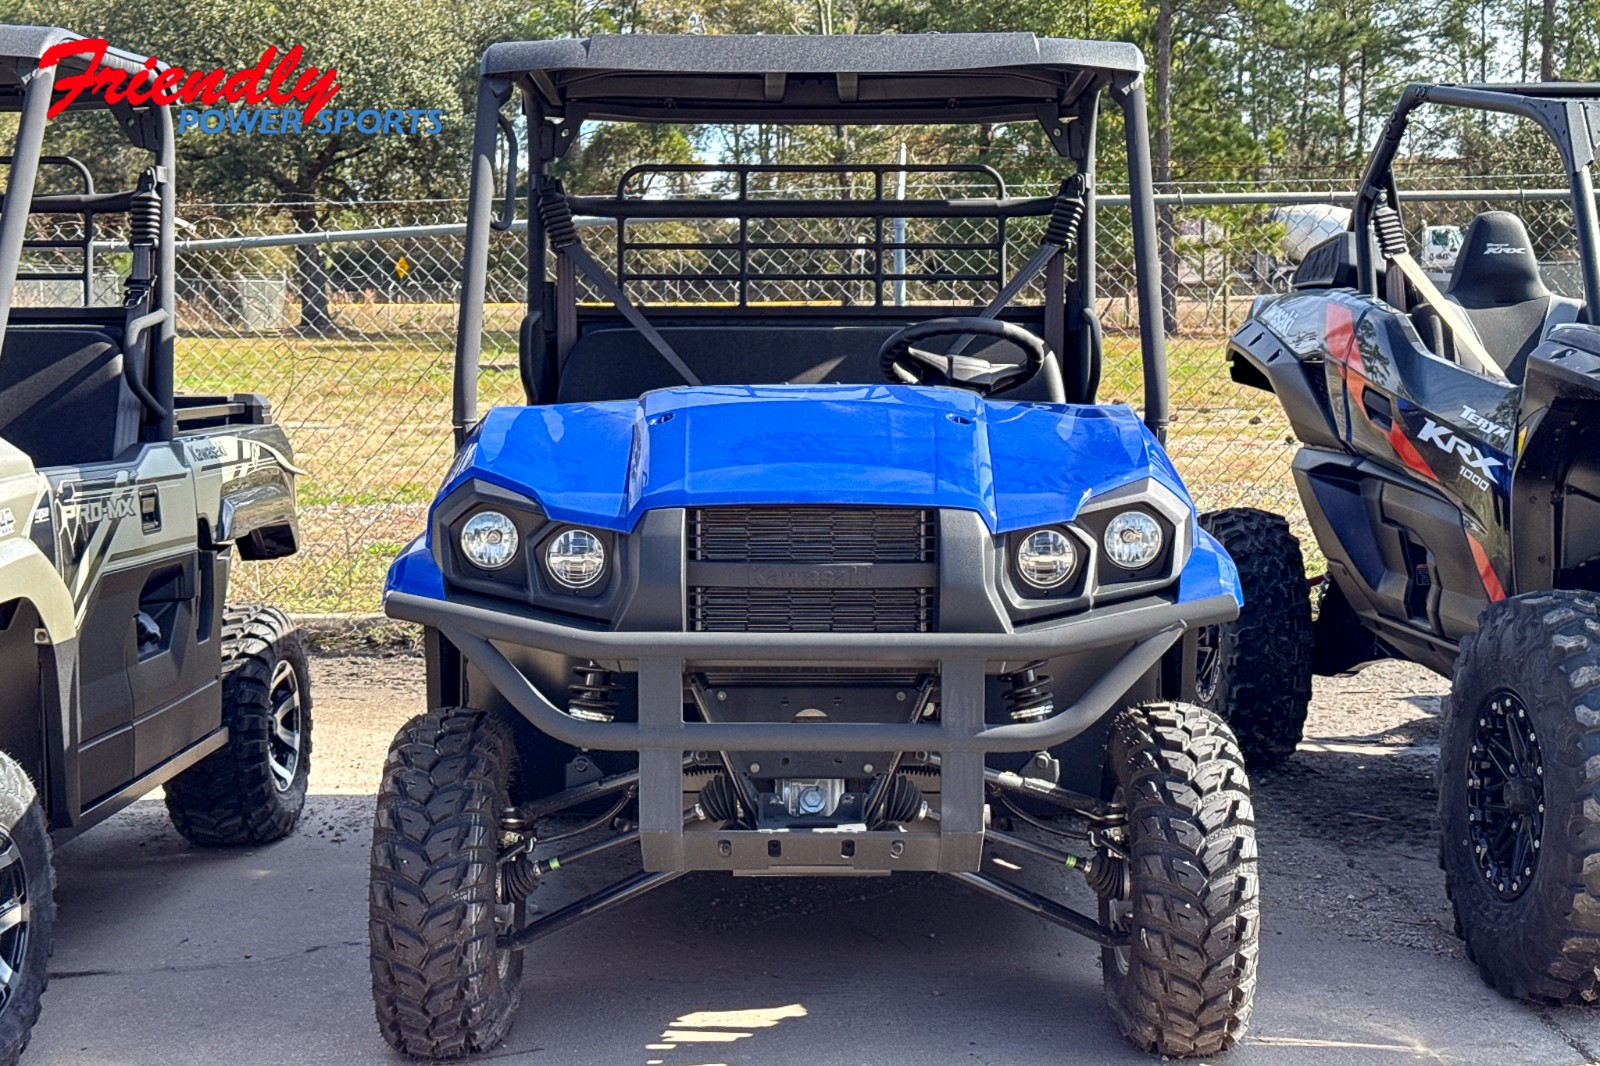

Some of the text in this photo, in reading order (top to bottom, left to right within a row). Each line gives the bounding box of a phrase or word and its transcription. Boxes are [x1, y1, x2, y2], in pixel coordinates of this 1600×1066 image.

[1483, 247, 1526, 255] KRX
[1416, 416, 1504, 484] KRX
[1459, 465, 1490, 492] 1000
[61, 496, 137, 524] PRO-MX
[748, 564, 873, 587] Kawasaki
